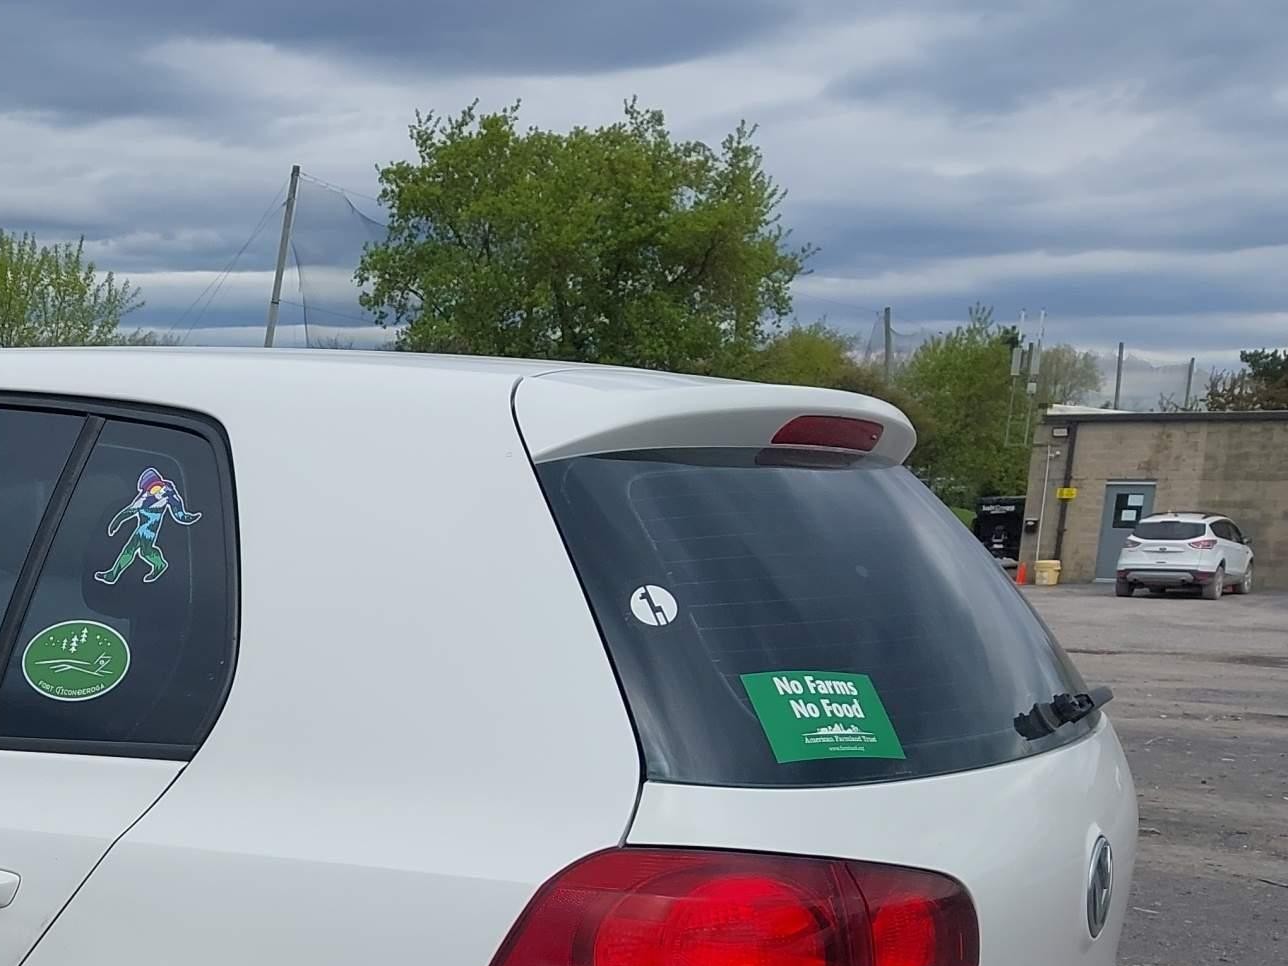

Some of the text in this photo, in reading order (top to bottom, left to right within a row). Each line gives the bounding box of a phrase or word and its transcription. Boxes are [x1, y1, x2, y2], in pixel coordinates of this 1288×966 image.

[38, 680, 54, 692] FORT
[773, 676, 858, 696] No Farms
[789, 699, 865, 718] No Food
[804, 736, 834, 744] American
